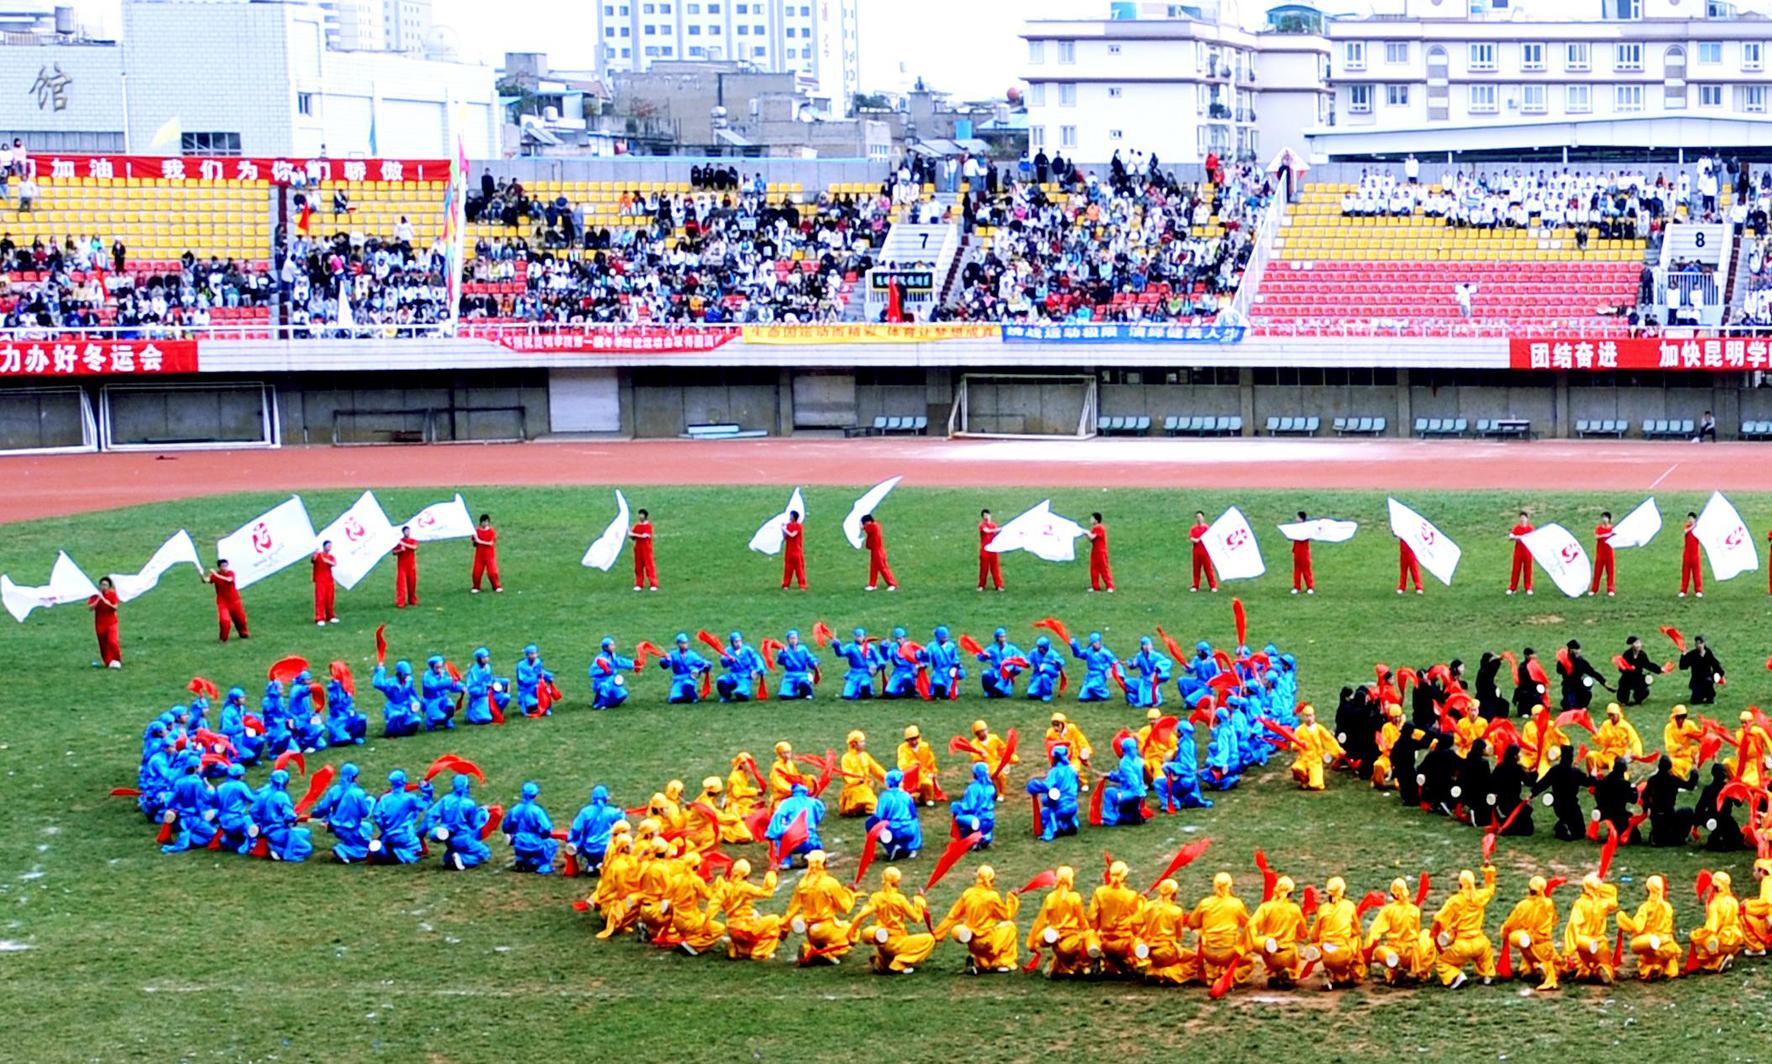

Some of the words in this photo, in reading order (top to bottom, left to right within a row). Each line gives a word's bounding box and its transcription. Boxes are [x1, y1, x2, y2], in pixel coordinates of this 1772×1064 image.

[28, 61, 72, 112] 馆
[918, 232, 929, 249] 7
[1695, 231, 1706, 248] 8
[0, 343, 164, 373] 力办好冬运会
[1530, 341, 1618, 369] 团结奋进
